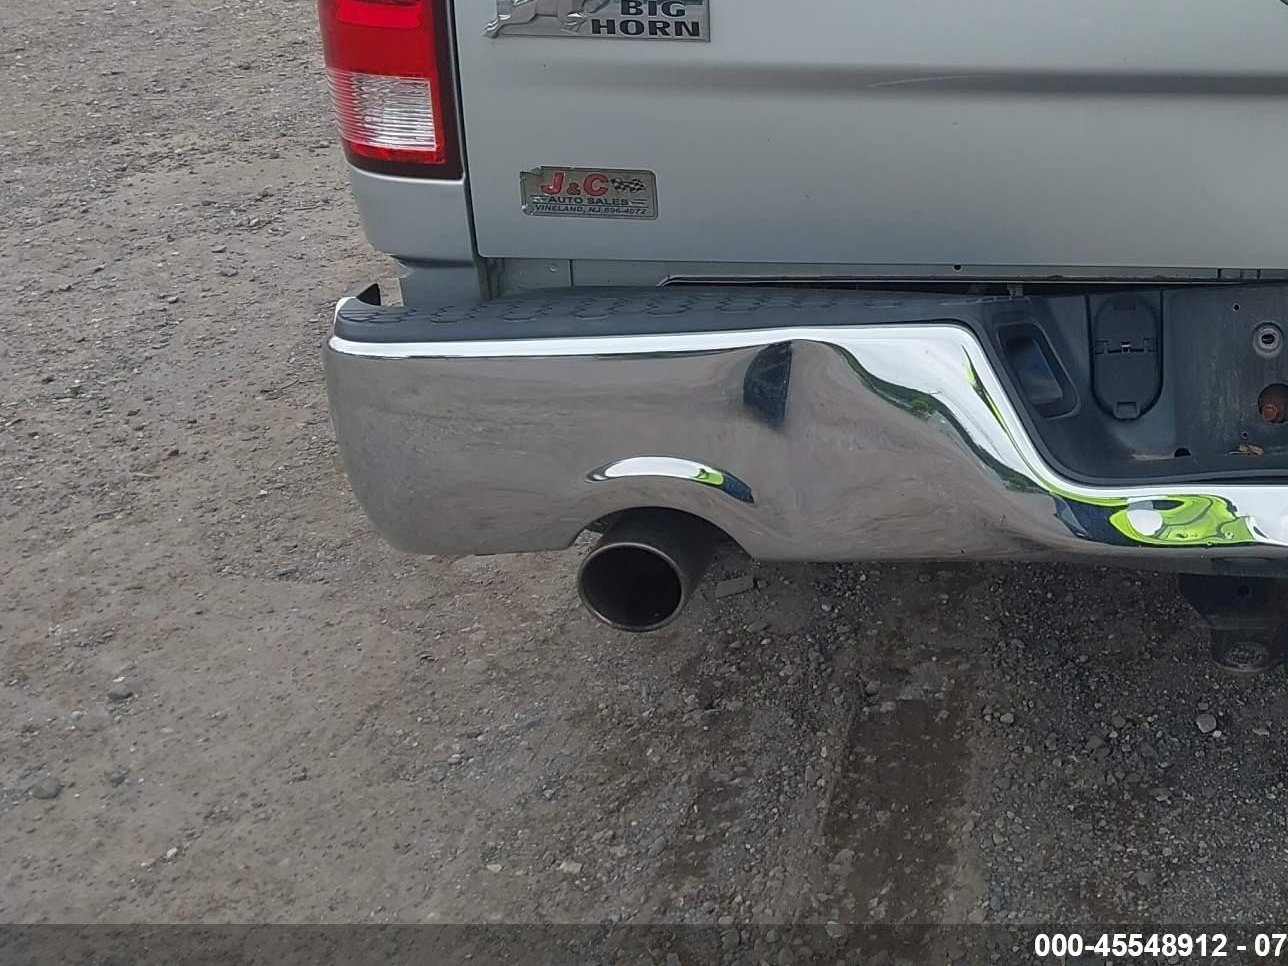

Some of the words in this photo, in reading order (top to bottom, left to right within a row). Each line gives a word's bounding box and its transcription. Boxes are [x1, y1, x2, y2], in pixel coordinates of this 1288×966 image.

[620, 0, 686, 17] BIG
[591, 19, 700, 37] HORN
[548, 196, 583, 204] AUTO
[587, 197, 628, 206] SALES
[535, 204, 586, 214] VINELAND,
